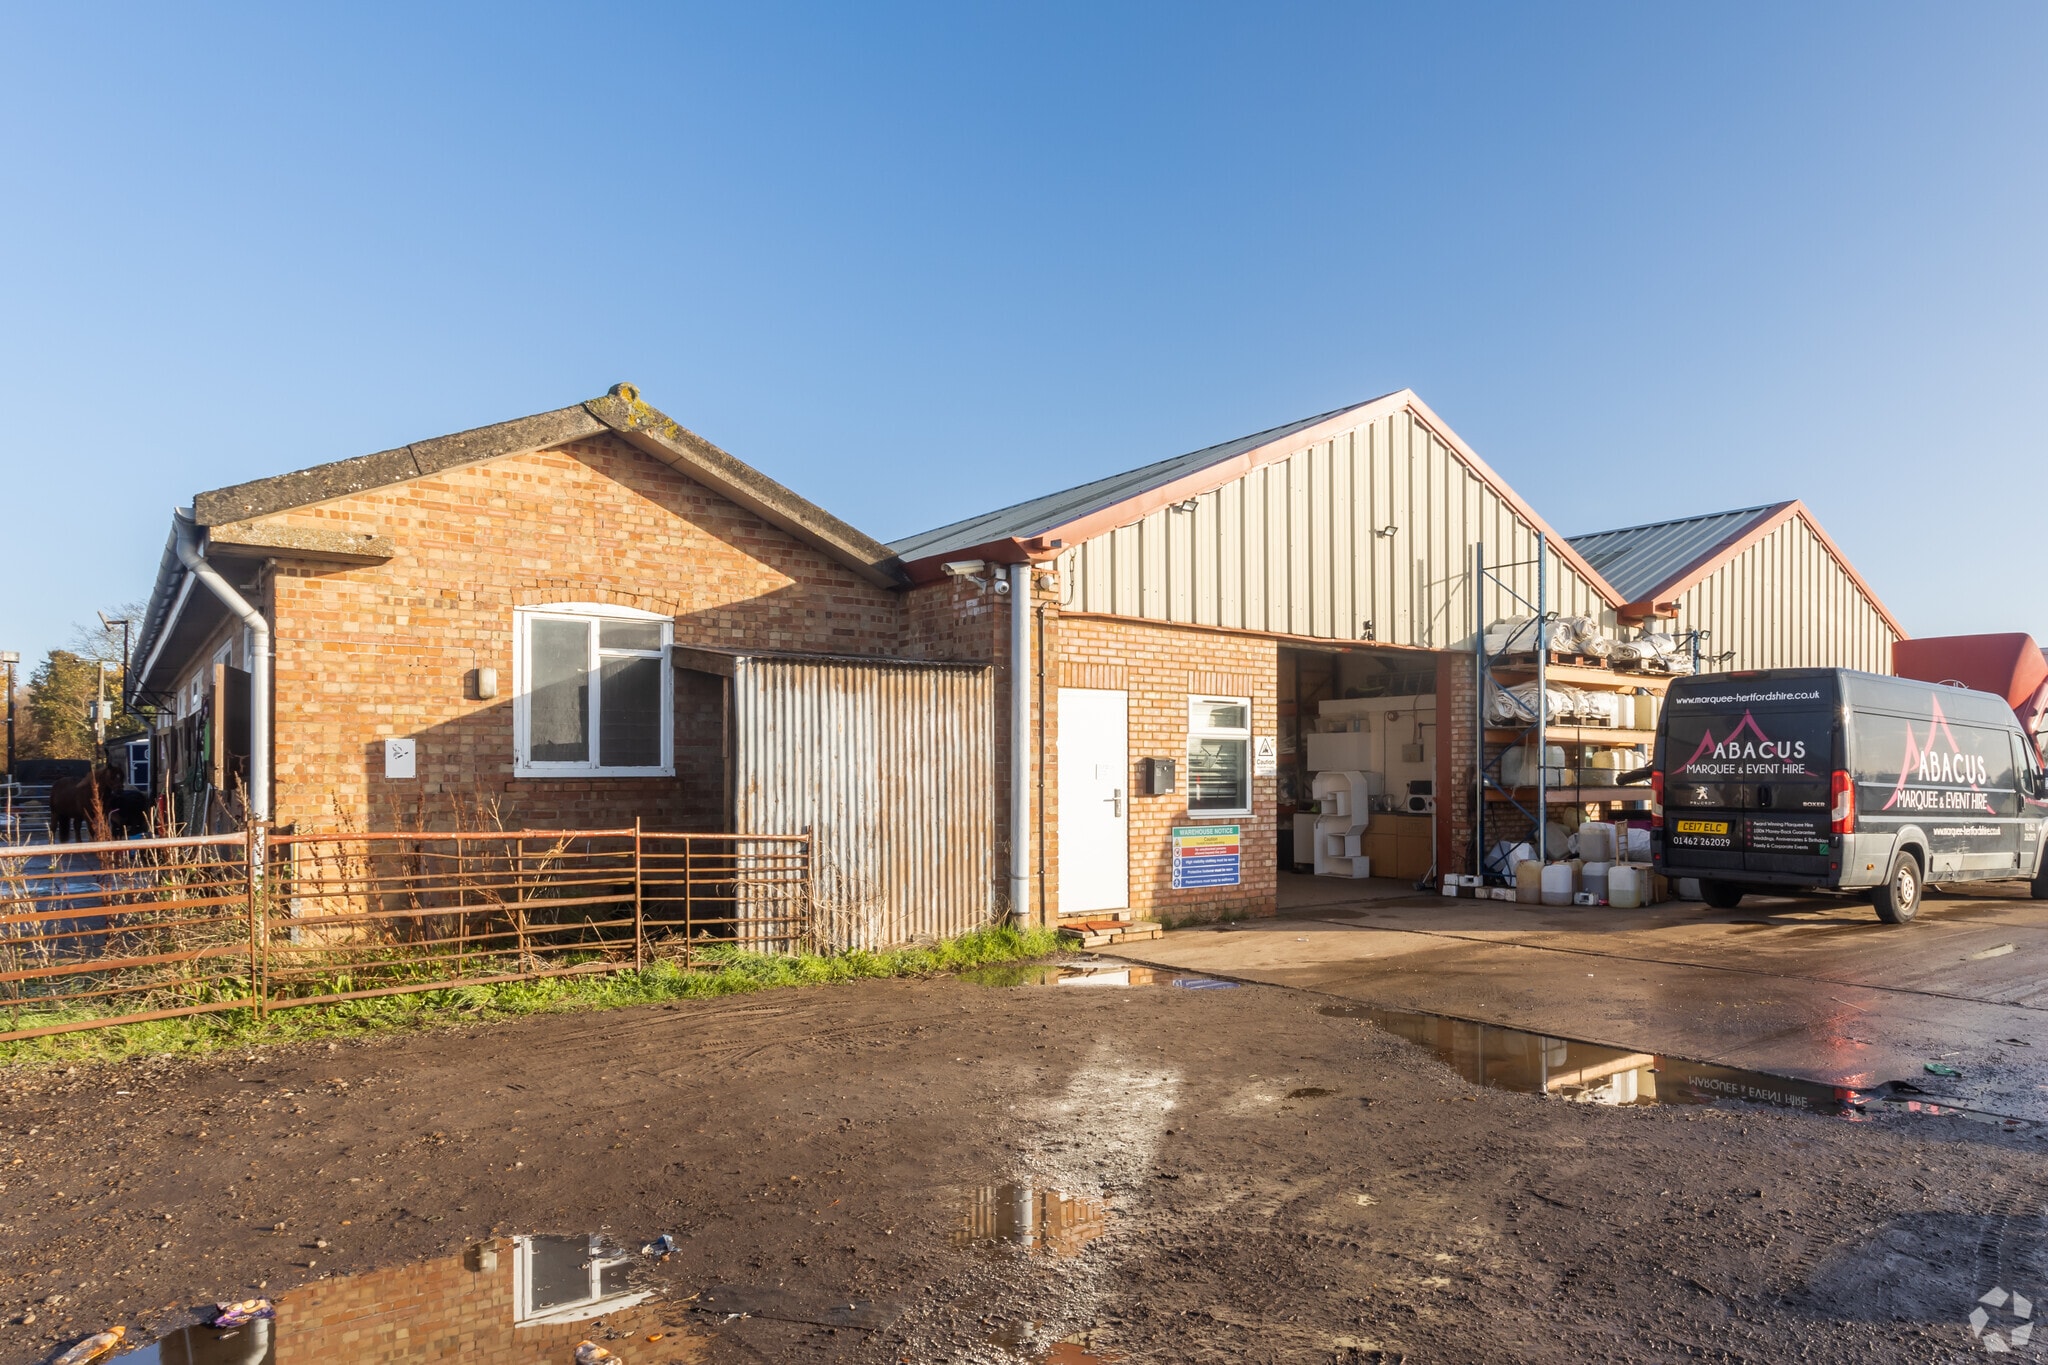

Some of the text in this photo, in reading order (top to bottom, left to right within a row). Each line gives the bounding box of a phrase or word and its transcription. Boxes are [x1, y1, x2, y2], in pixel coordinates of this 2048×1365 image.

[1676, 690, 1820, 705] www.marquee-hertfordshire.co.uk
[1713, 741, 1806, 759] ABACUS
[1687, 764, 1735, 774] MARQUEE
[1747, 764, 1780, 774] EVENT
[1783, 764, 1805, 774] HIRE
[1918, 750, 1986, 784] ABACUS
[1897, 788, 1988, 810] MARQUEE & EVENT HIRE
[1683, 822, 1721, 832] CE17 ELC
[1673, 837, 1731, 847] 01462 262029
